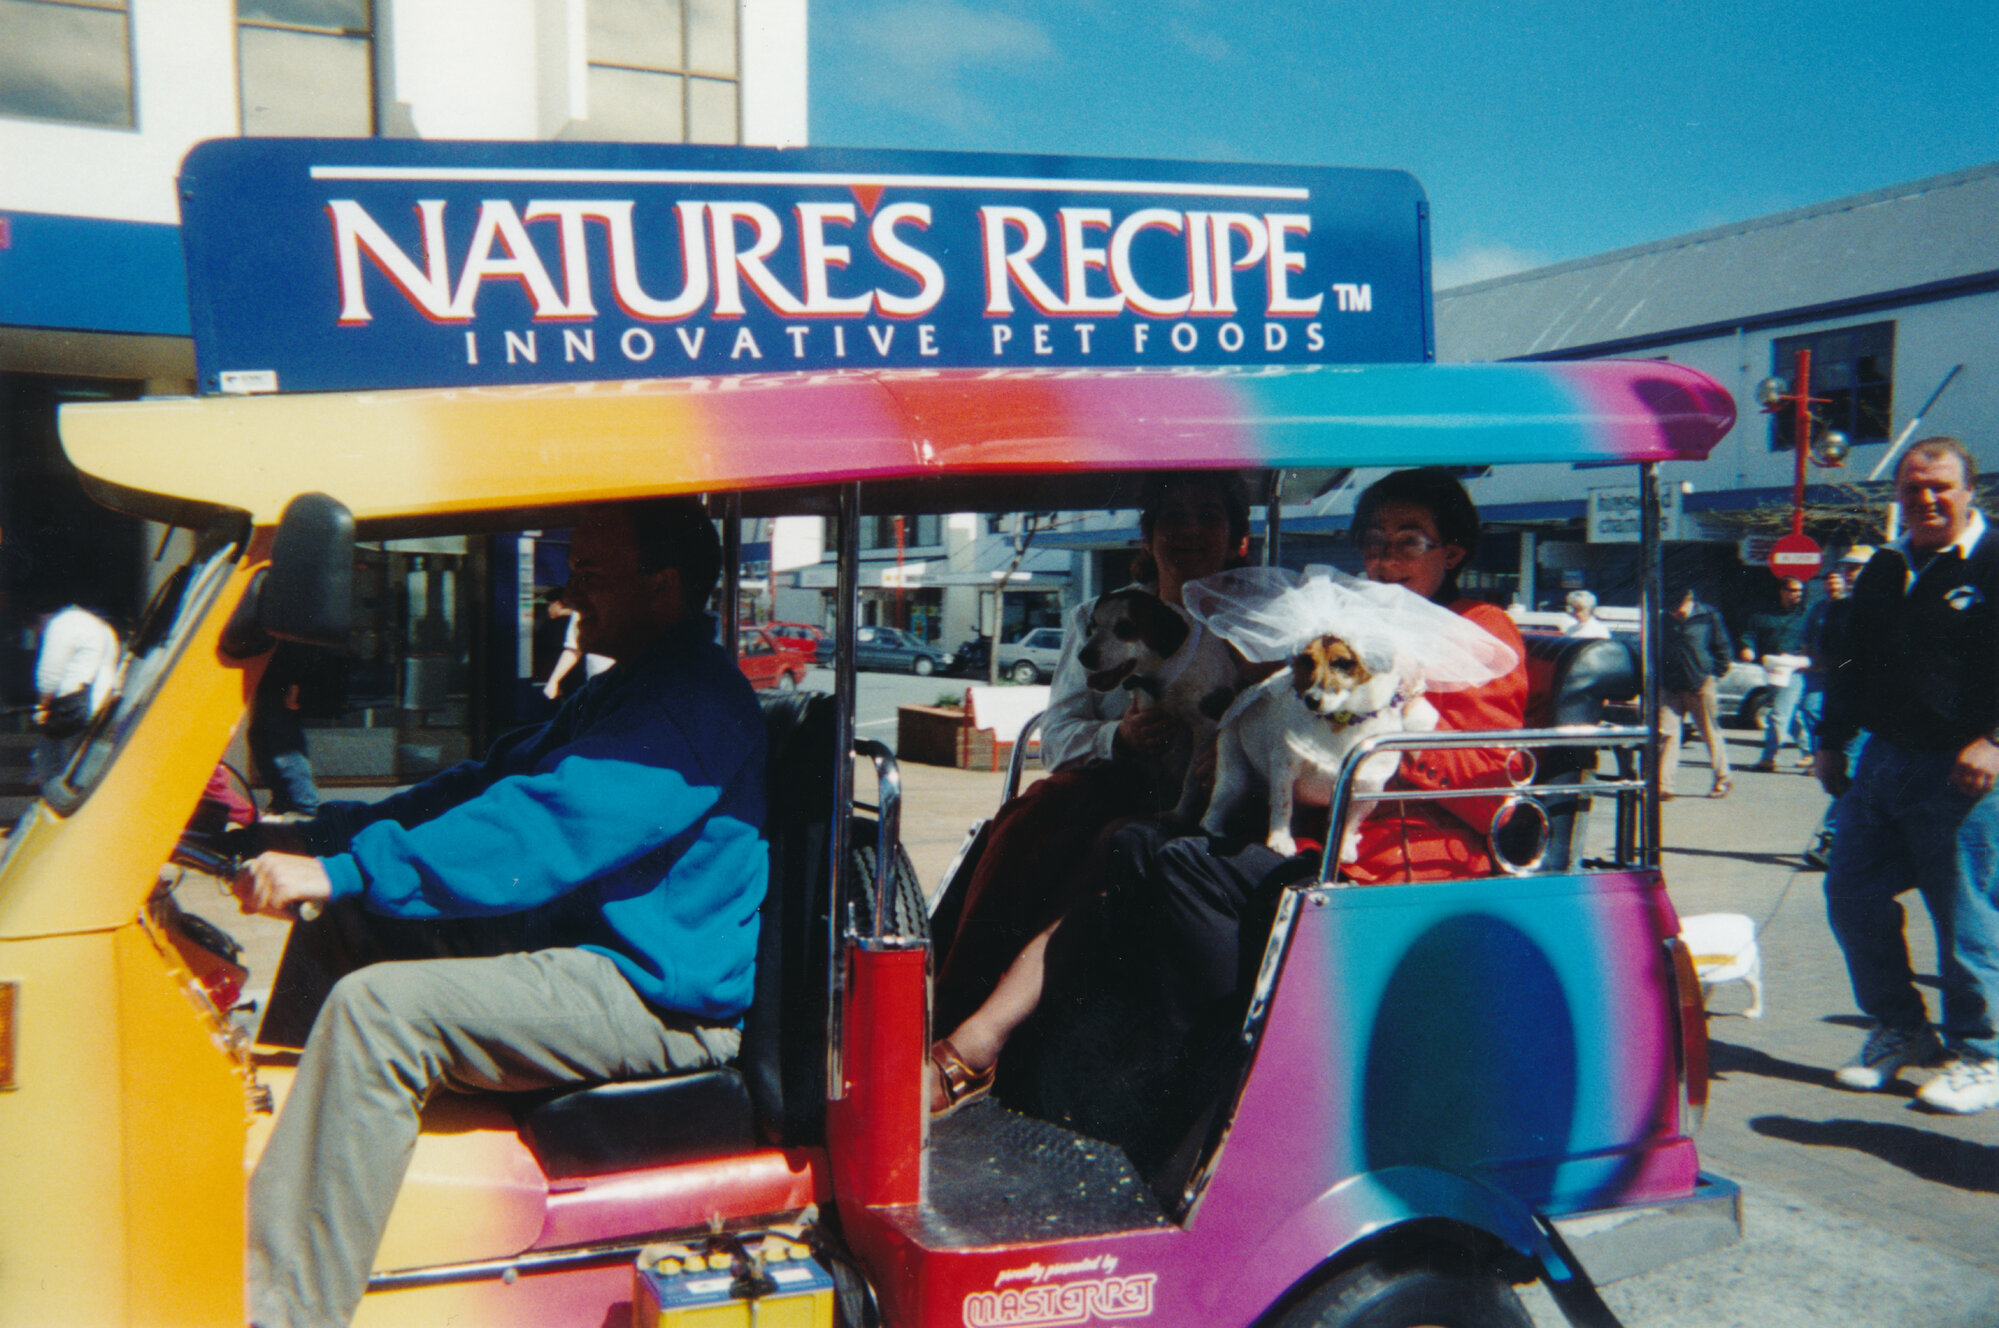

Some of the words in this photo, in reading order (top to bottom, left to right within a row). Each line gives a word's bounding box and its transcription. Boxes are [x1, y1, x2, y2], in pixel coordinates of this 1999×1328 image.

[977, 204, 1324, 320] RECIPE
[464, 325, 940, 365] INNOVATIVE
[992, 323, 1096, 356] PET
[1133, 321, 1326, 354] FOODS
[1100, 1253, 1119, 1275] by
